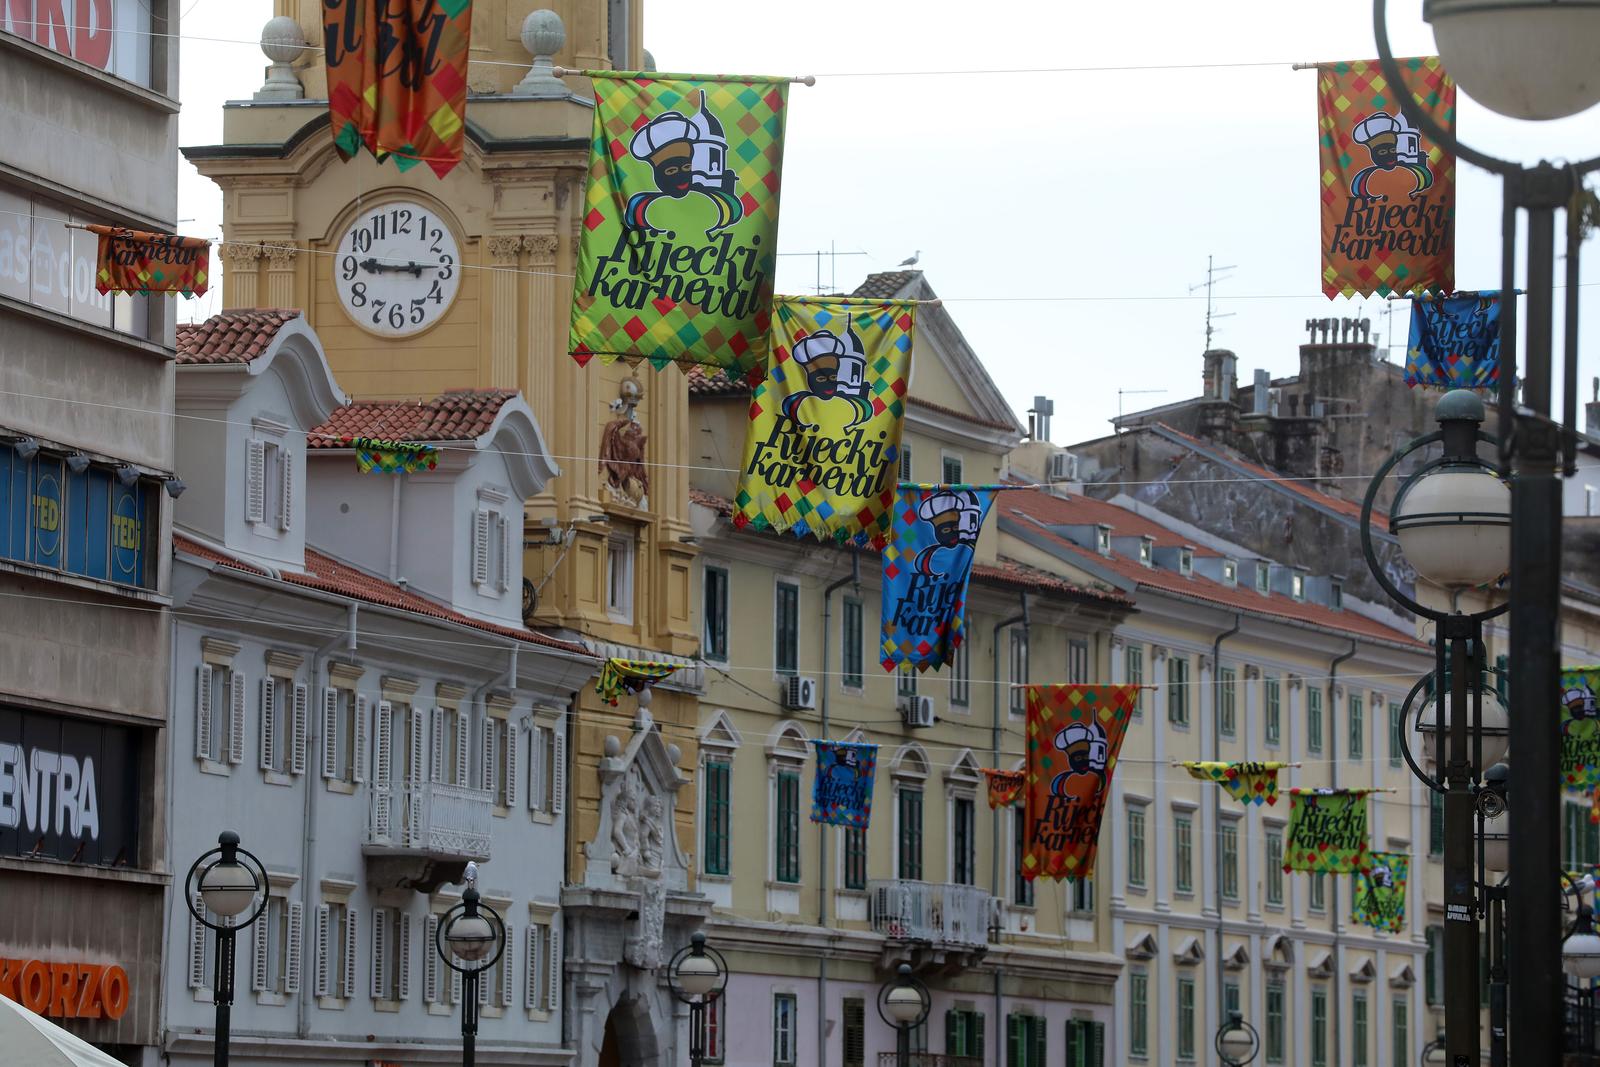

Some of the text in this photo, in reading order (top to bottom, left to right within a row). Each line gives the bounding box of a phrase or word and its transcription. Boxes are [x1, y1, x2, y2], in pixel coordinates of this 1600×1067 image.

[371, 214, 386, 240] 11
[391, 209, 412, 234] 12
[419, 215, 427, 240] 1
[350, 228, 372, 253] 10
[430, 229, 443, 254] 2
[342, 255, 358, 280] 9
[438, 254, 453, 280] 3
[351, 282, 367, 307] 8
[427, 280, 443, 304] 4
[588, 254, 764, 320] karneval
[371, 299, 386, 324] 7
[389, 303, 405, 329] 6
[410, 297, 427, 324] 5
[767, 413, 888, 476] Riječki
[747, 441, 890, 499] karneval
[112, 514, 142, 551] TEDi
